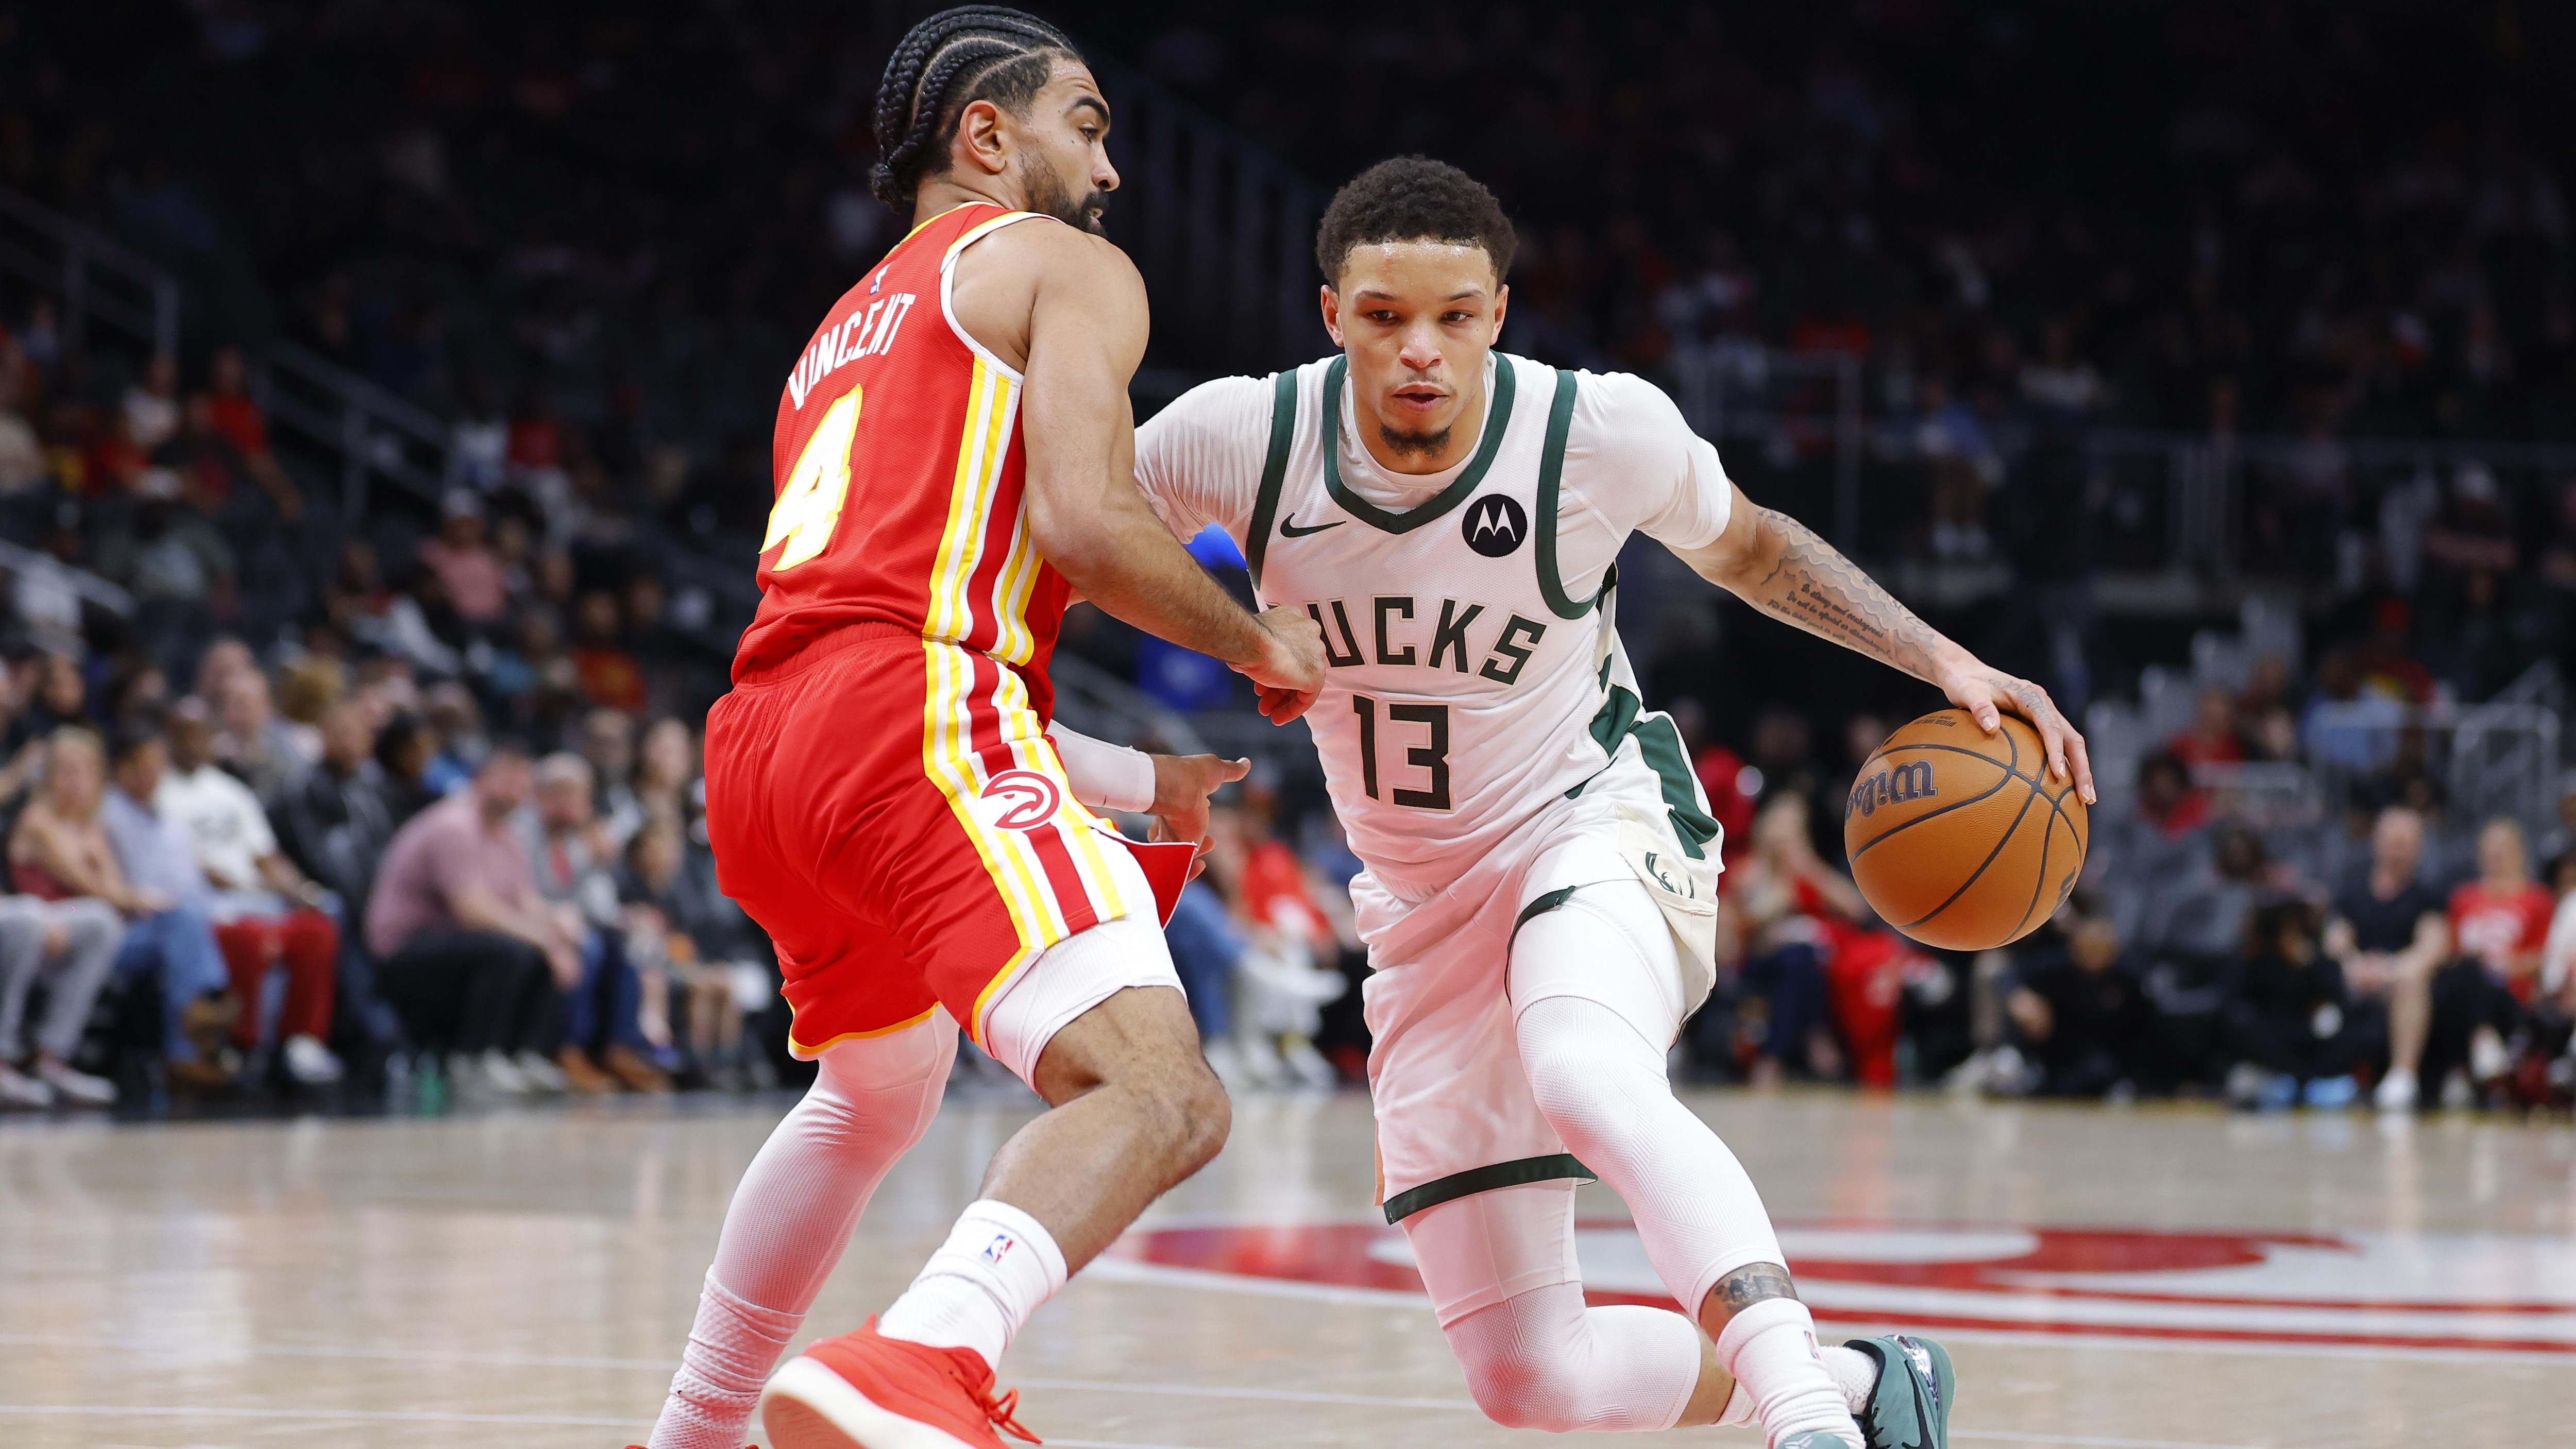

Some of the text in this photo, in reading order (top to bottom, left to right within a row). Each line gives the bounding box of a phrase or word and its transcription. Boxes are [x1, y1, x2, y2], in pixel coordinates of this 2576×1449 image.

[788, 293, 916, 411] VINCENT
[759, 383, 863, 572] 4
[1266, 593, 1548, 686] UCKS
[1352, 692, 1454, 812] 13
[1845, 759, 1938, 822] Wils
